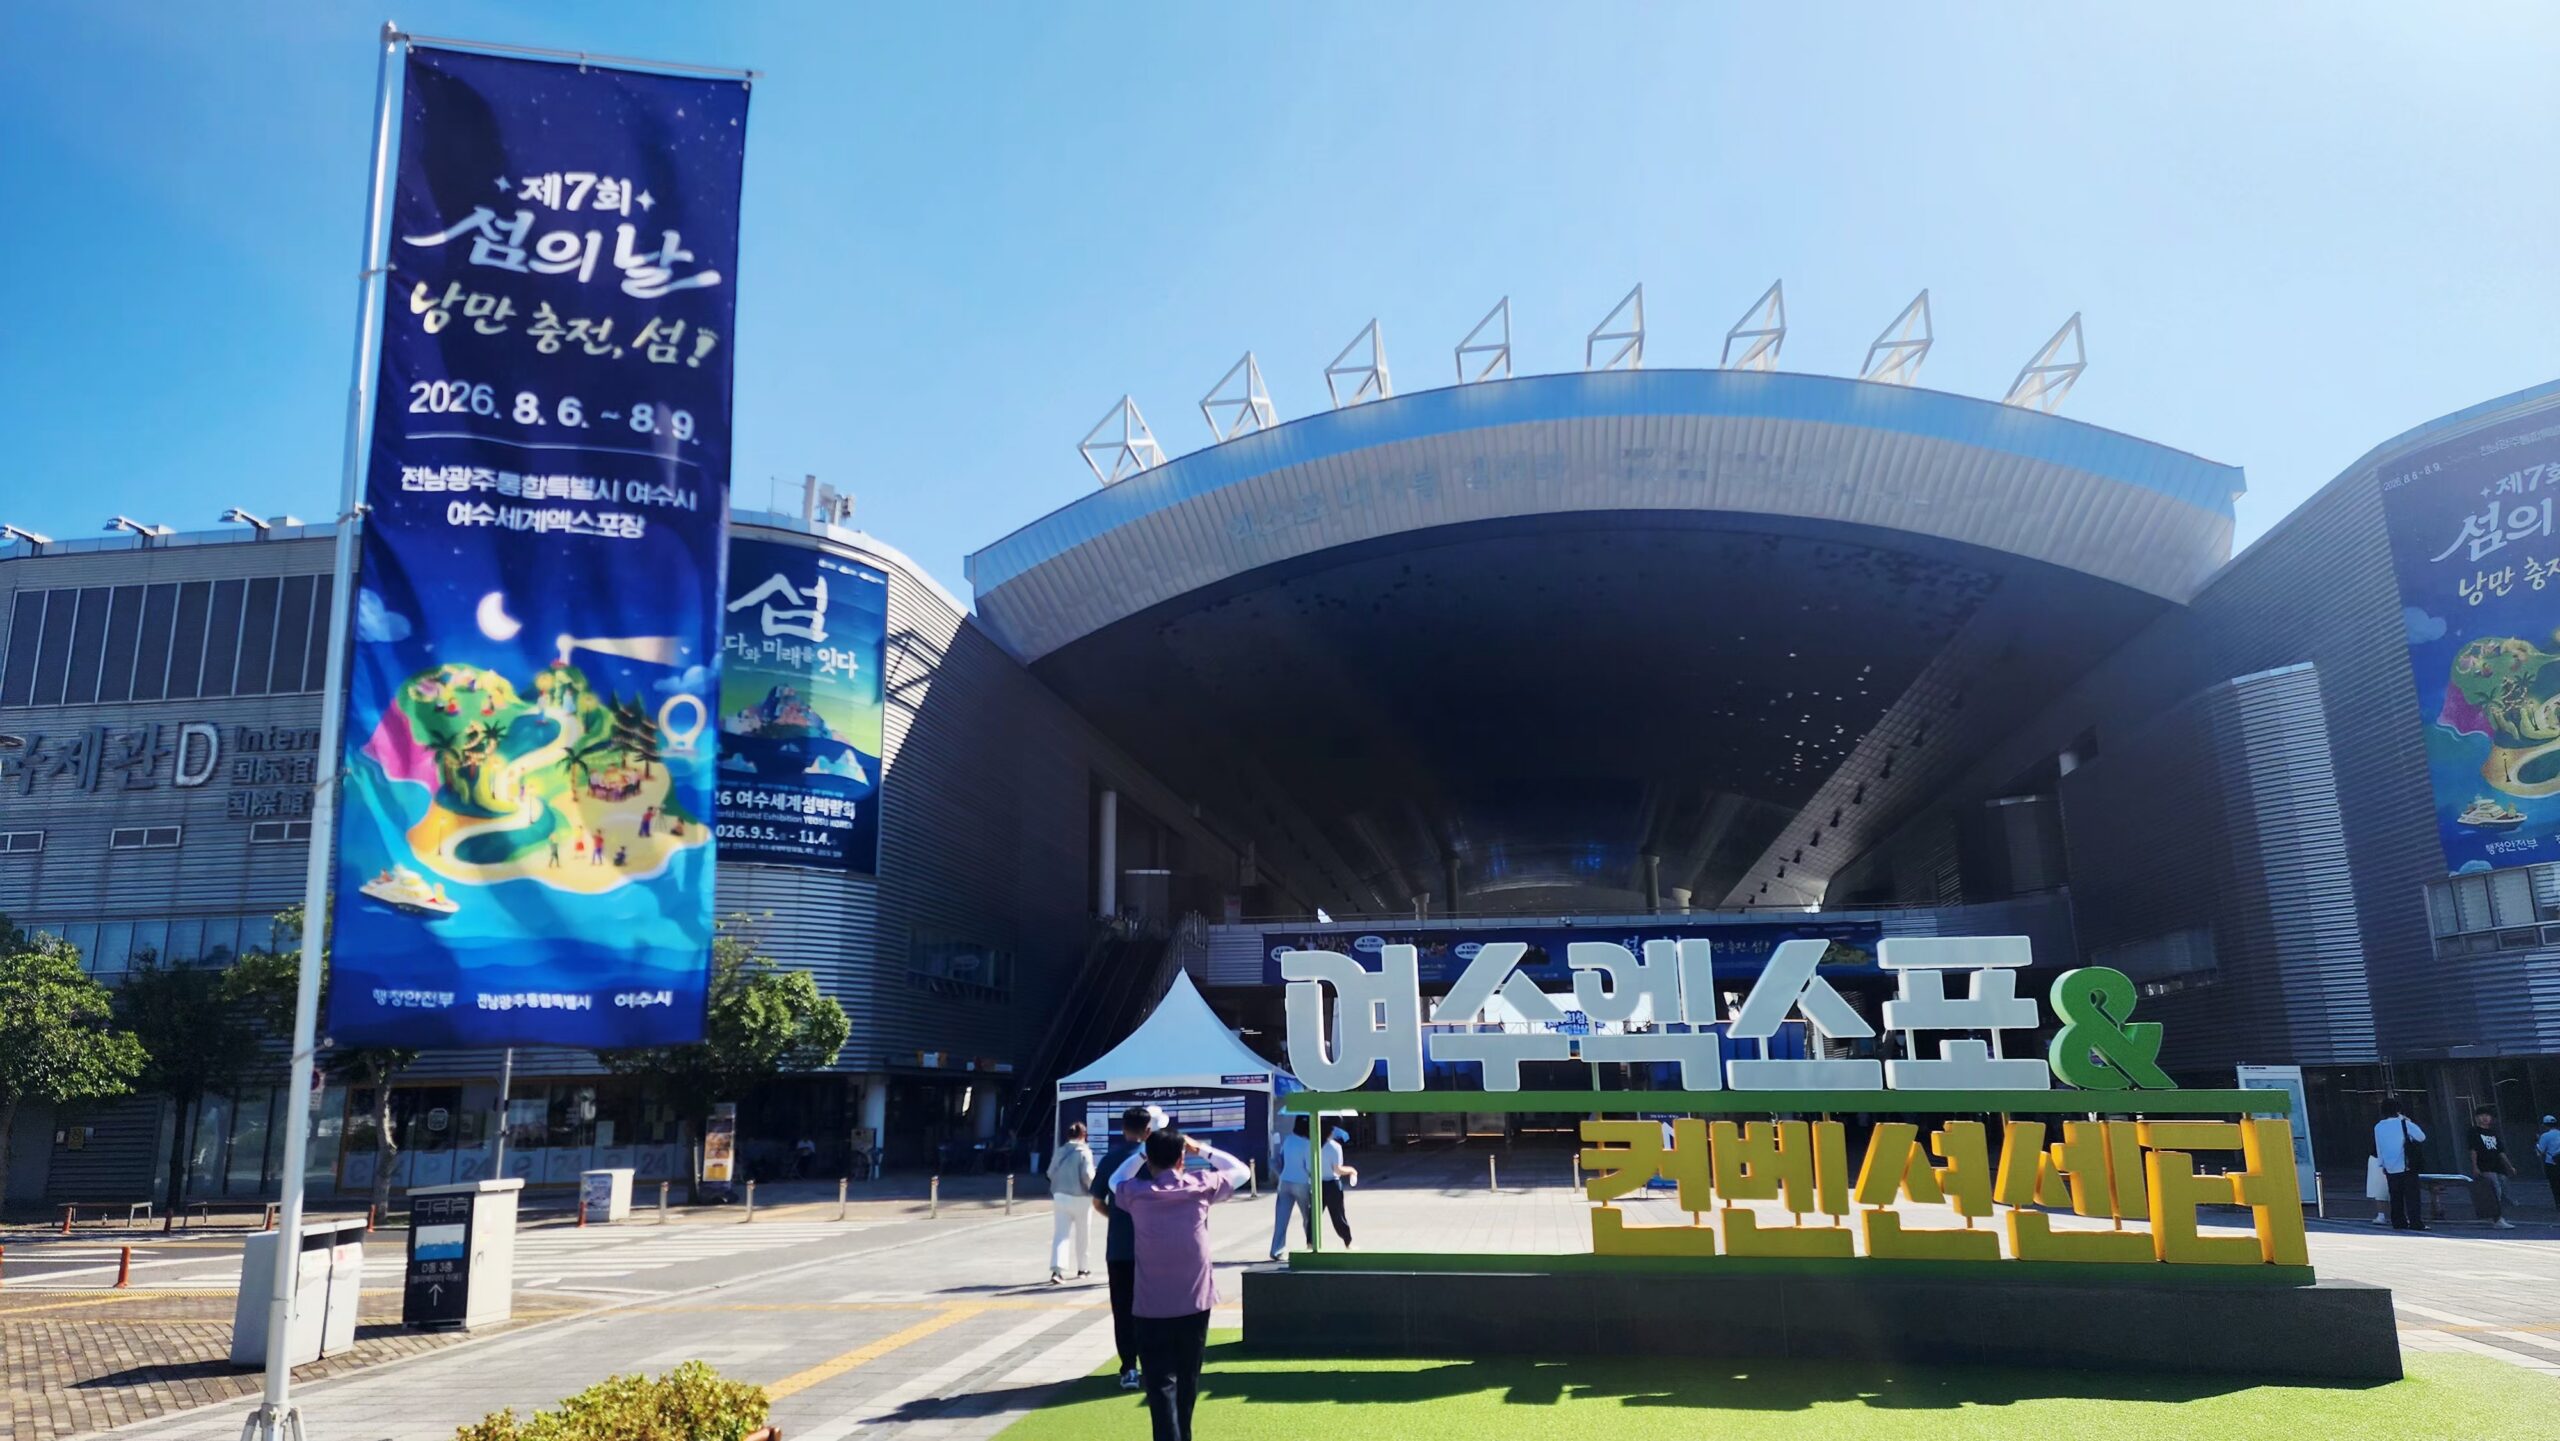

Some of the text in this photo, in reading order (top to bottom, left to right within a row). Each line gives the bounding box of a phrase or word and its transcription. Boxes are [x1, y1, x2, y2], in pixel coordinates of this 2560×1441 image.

[518, 171, 632, 217] 제7회
[410, 281, 517, 334] 낭만
[526, 301, 624, 359] 충전,
[409, 379, 501, 419] 2026.
[401, 465, 697, 511] 전남광주통합특별시 여수시
[447, 500, 647, 539] 여수세계엑스포장
[726, 573, 829, 643] 섬
[2458, 566, 2515, 606] 낭만
[722, 632, 761, 664] 다와
[816, 647, 859, 679] 잇다
[2485, 839, 2539, 855] 행정안전부
[614, 990, 674, 1008] 여수시
[1281, 936, 2177, 1092] 여수엑스포 &
[1581, 1118, 2309, 1265] 컨벤션센터
